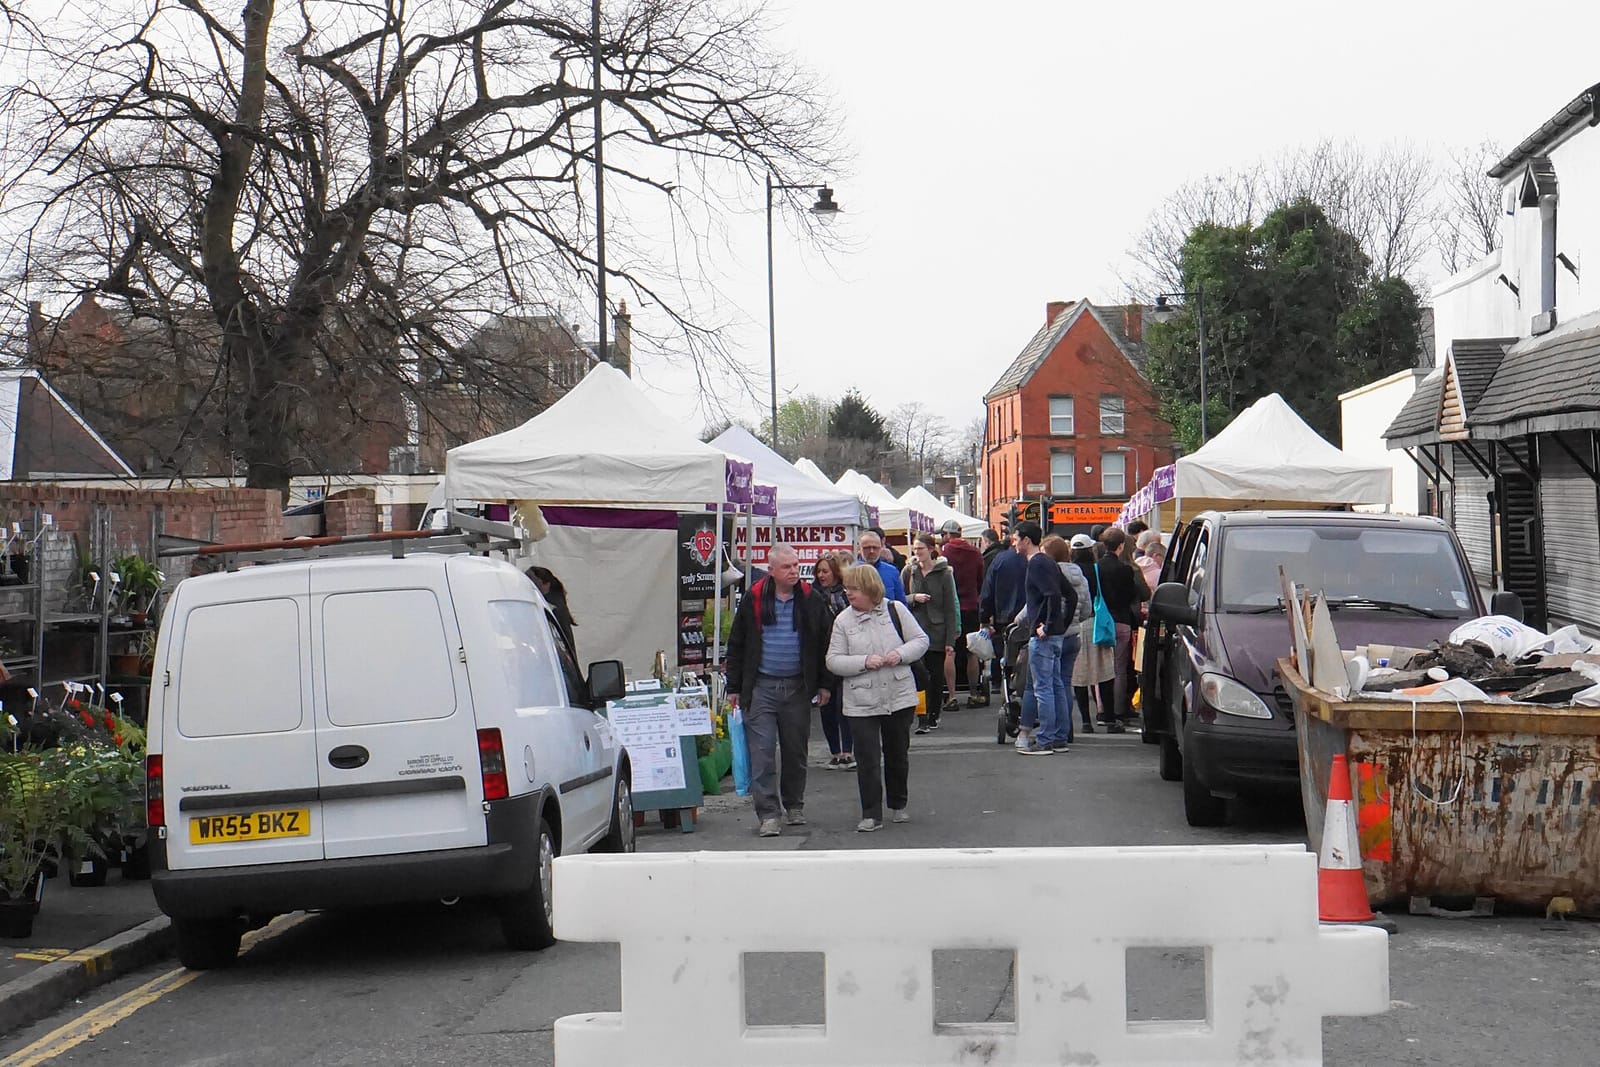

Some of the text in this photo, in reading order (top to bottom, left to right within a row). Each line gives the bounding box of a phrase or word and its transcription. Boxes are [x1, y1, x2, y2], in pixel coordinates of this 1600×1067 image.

[1099, 506, 1122, 514] TURK
[756, 526, 845, 543] MARKETS
[698, 537, 712, 551] TS
[681, 573, 696, 585] Truly
[199, 811, 300, 838] WR55 BKZ
